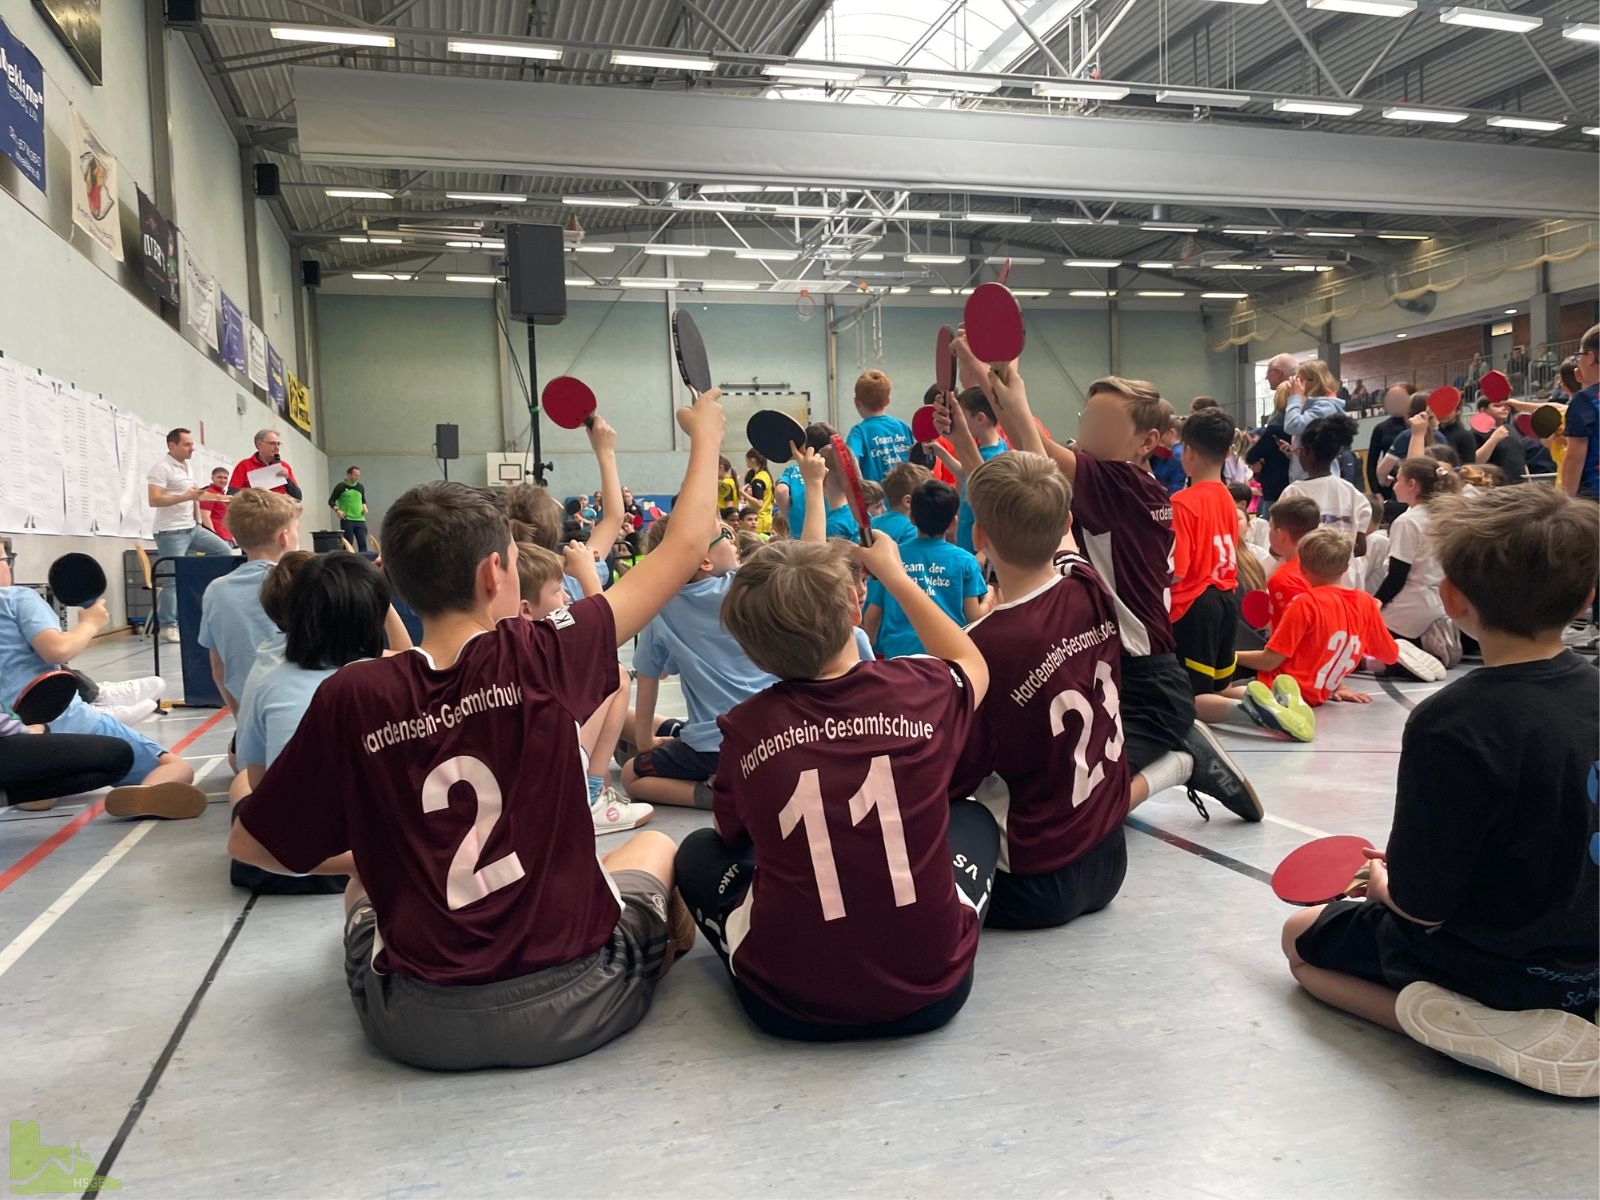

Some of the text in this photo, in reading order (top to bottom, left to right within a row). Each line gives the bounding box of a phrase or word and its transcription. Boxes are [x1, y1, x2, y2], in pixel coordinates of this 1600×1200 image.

[928, 562, 946, 574] der
[1313, 630, 1360, 691] 26
[739, 712, 934, 780] Hardenstein-Gesamtschule
[421, 754, 526, 911] 2
[777, 754, 917, 922] 11
[718, 863, 740, 895] JAKO
